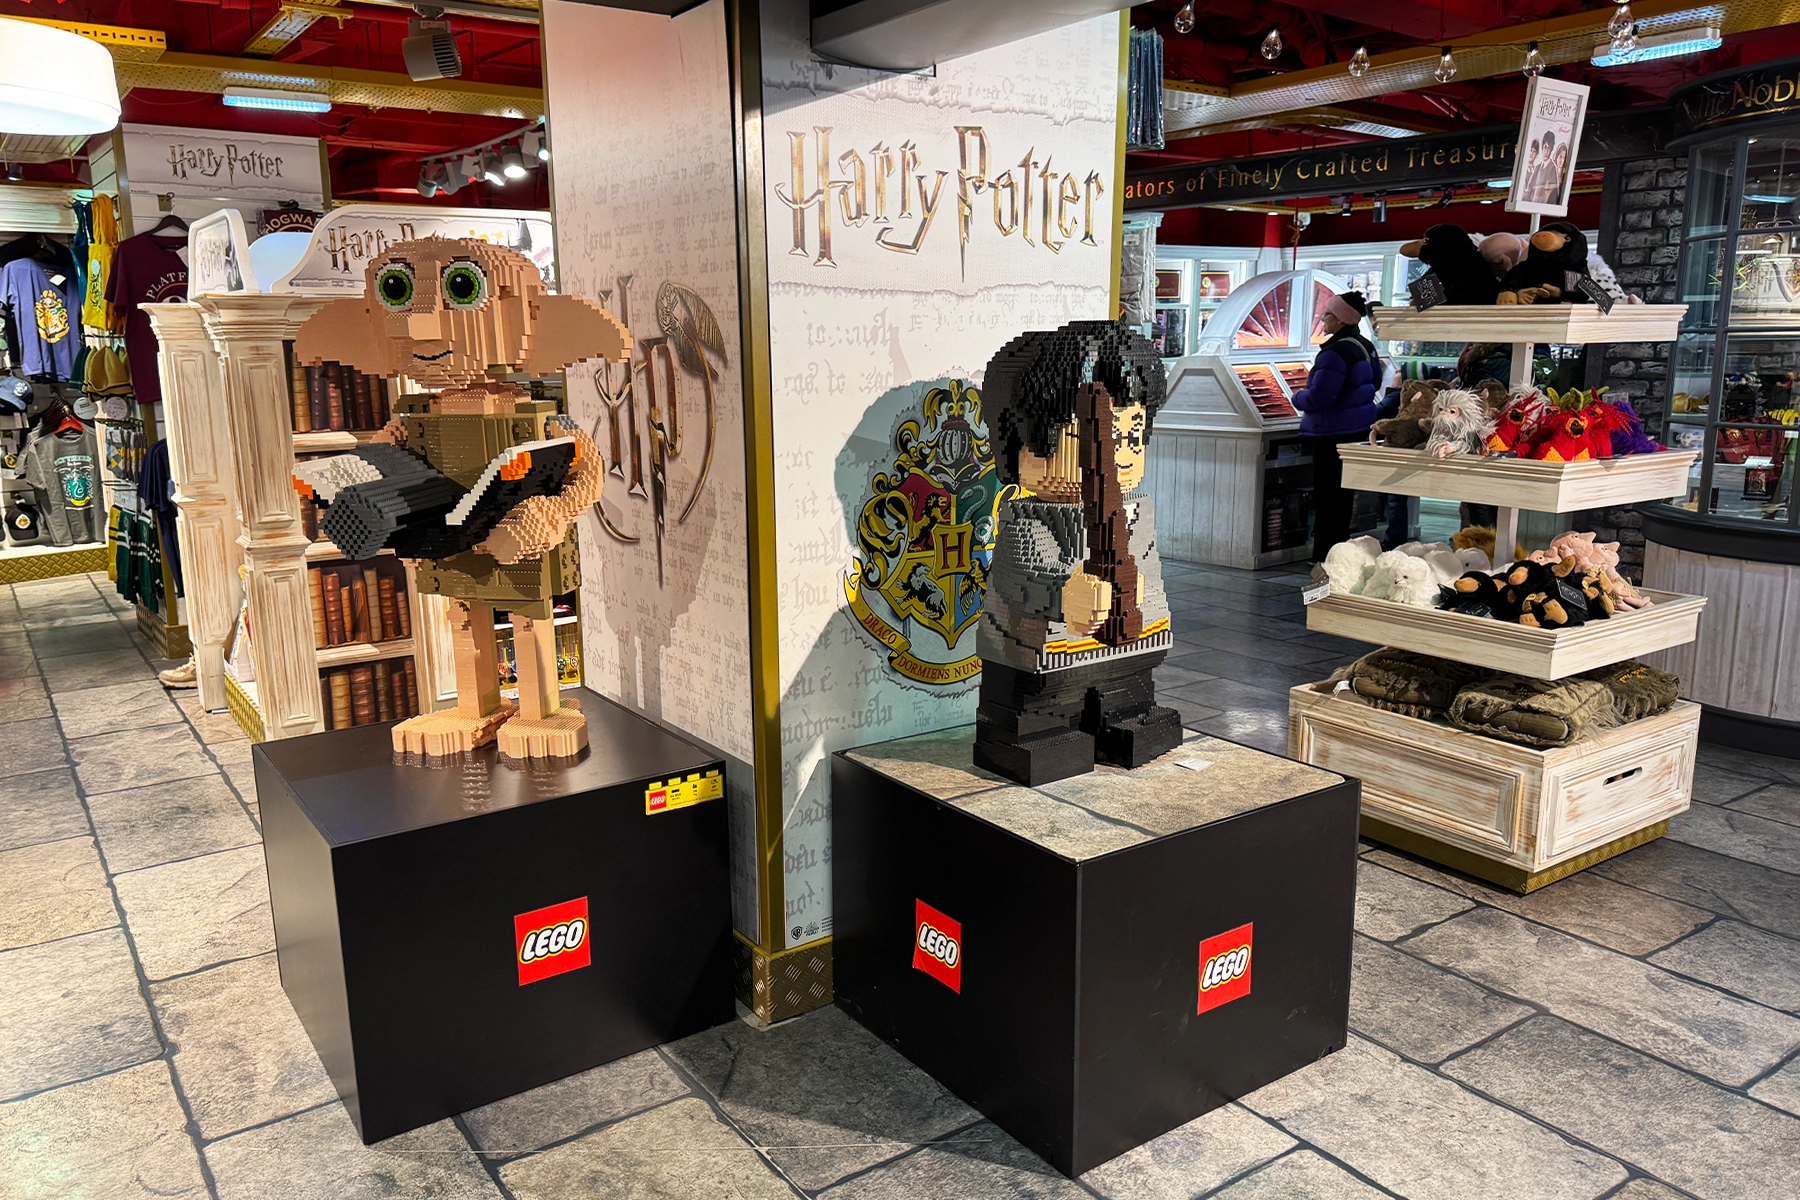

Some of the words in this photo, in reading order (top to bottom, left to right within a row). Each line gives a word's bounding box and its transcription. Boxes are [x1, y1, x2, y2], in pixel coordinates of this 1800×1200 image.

[167, 144, 224, 180] Harry
[225, 144, 283, 185] Potter
[1186, 170, 1207, 192] of
[1218, 163, 1284, 190] Finely
[1296, 149, 1389, 179] Crafted
[1406, 142, 1517, 168] Treasur
[265, 213, 317, 234] HOGWA
[774, 126, 949, 268] Harry
[953, 126, 1104, 283] Potter
[323, 225, 397, 275] Harr
[863, 612, 897, 645] DRACO
[897, 656, 950, 680] DORMIENS
[520, 918, 587, 964] LEGO
[917, 921, 960, 968] LEGO
[1200, 944, 1251, 992] LEGO
